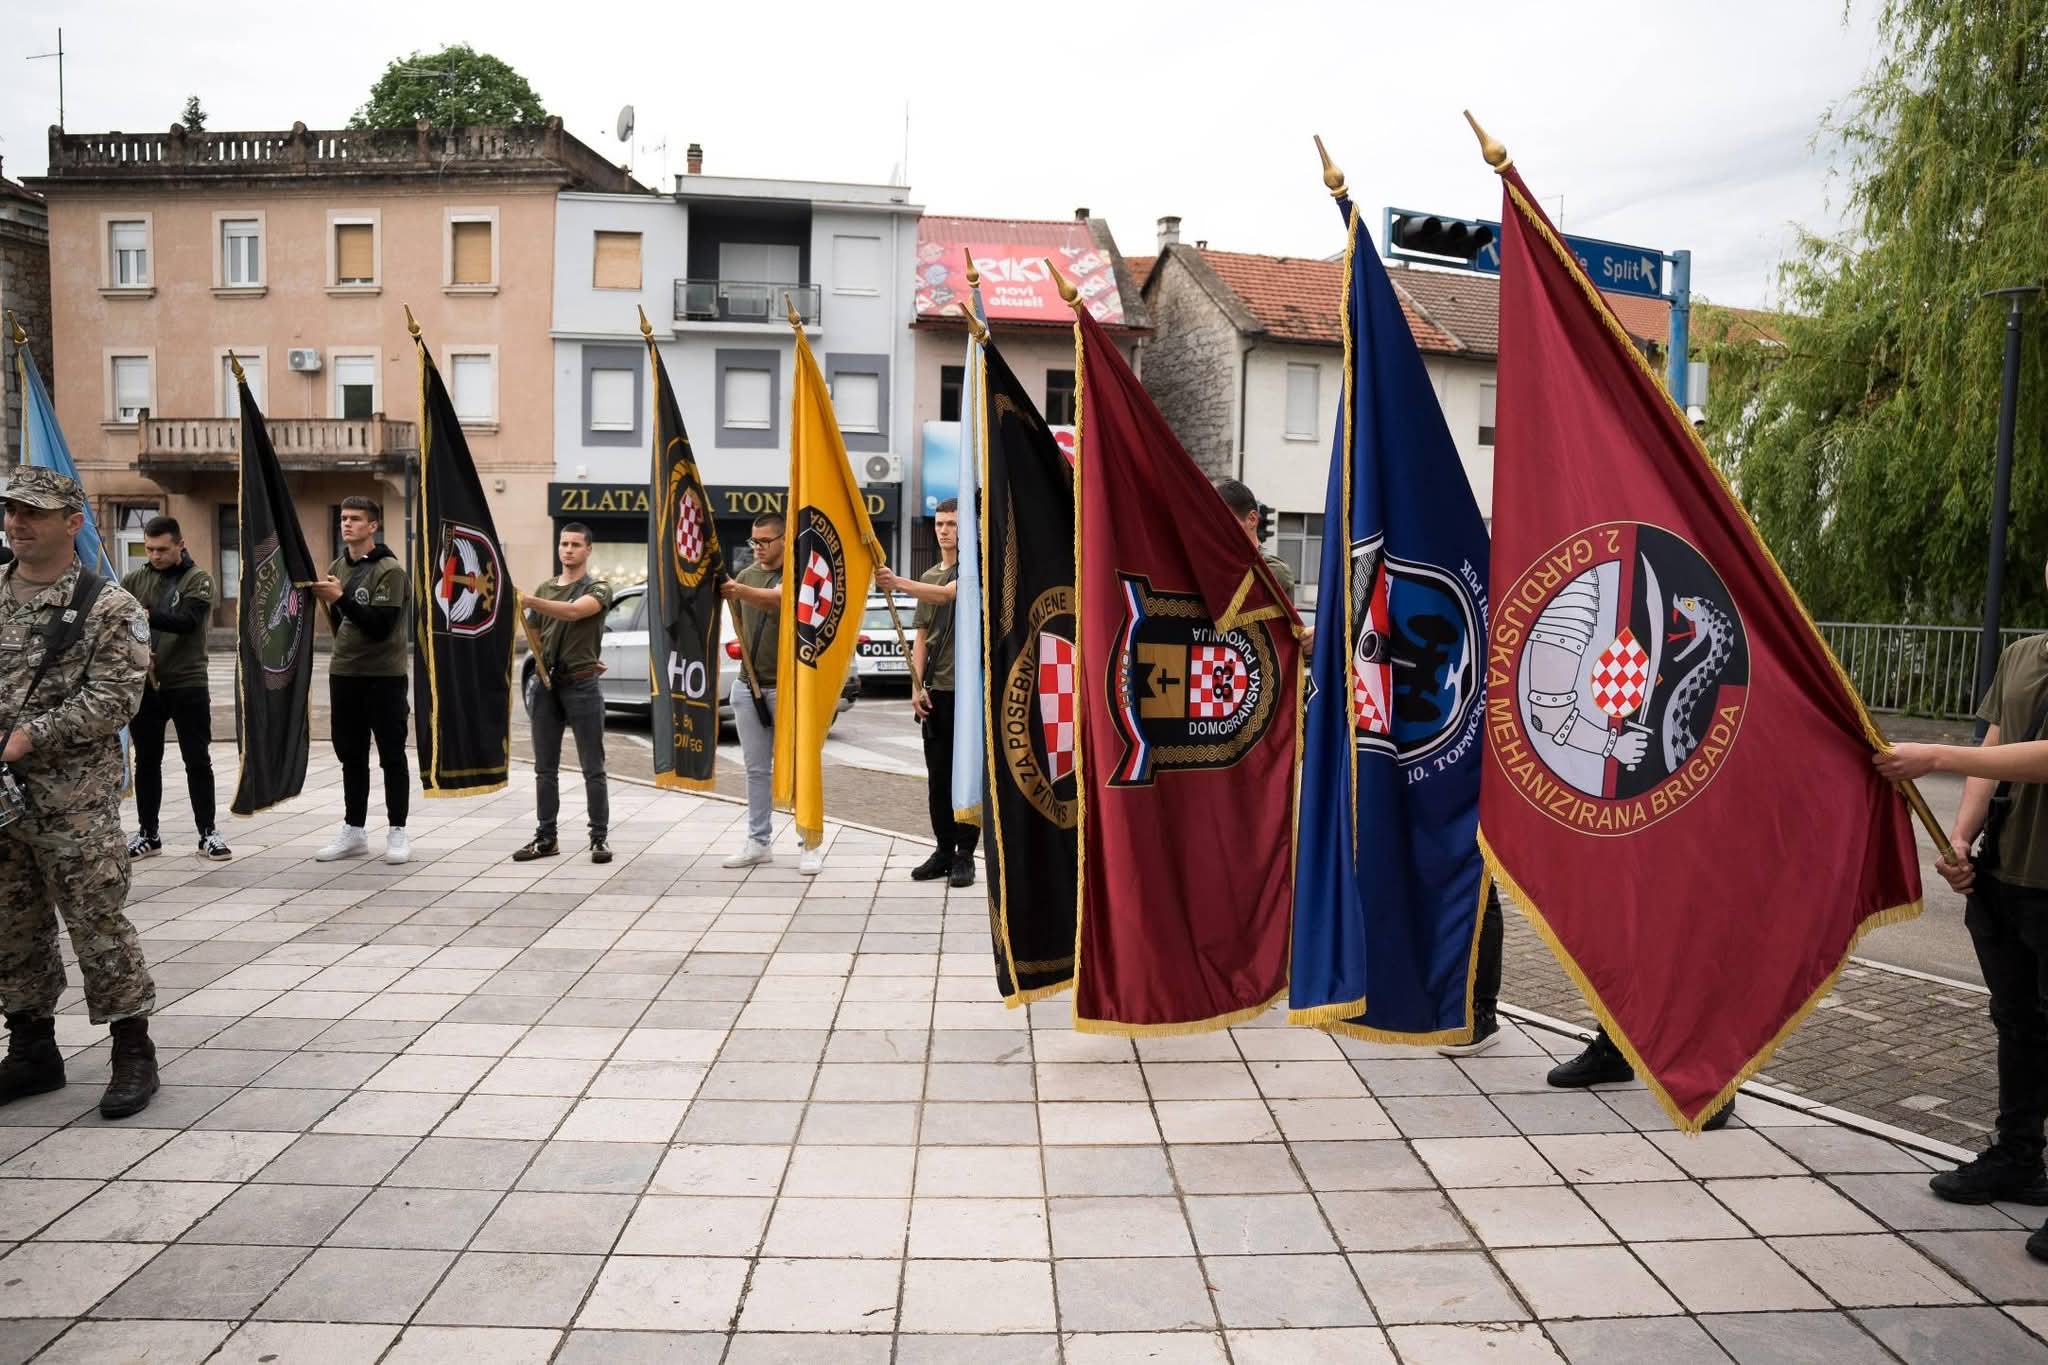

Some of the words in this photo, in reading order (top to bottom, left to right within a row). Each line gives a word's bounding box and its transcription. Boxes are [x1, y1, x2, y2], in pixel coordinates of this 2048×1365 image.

[1603, 256, 1639, 283] Split
[995, 285, 1034, 297] novi
[562, 489, 714, 514] ZLATA
[725, 491, 789, 513] TON
[810, 511, 841, 550] BRIGA
[1599, 529, 1620, 554] 2.
[824, 559, 845, 634] OKLOPNA
[1460, 559, 1484, 596] PUK
[1489, 539, 1593, 687] GARDIJSKA
[863, 644, 914, 656] POLIC
[1119, 650, 1132, 709] HVO
[1213, 658, 1234, 700] 83.
[1189, 669, 1260, 736] DOMOBRANSKA
[1015, 752, 1039, 784] ZA
[1407, 766, 1430, 785] 10.
[1489, 699, 1647, 831] MEHANIZIRANA
[1652, 704, 1740, 815] BRIGADA
